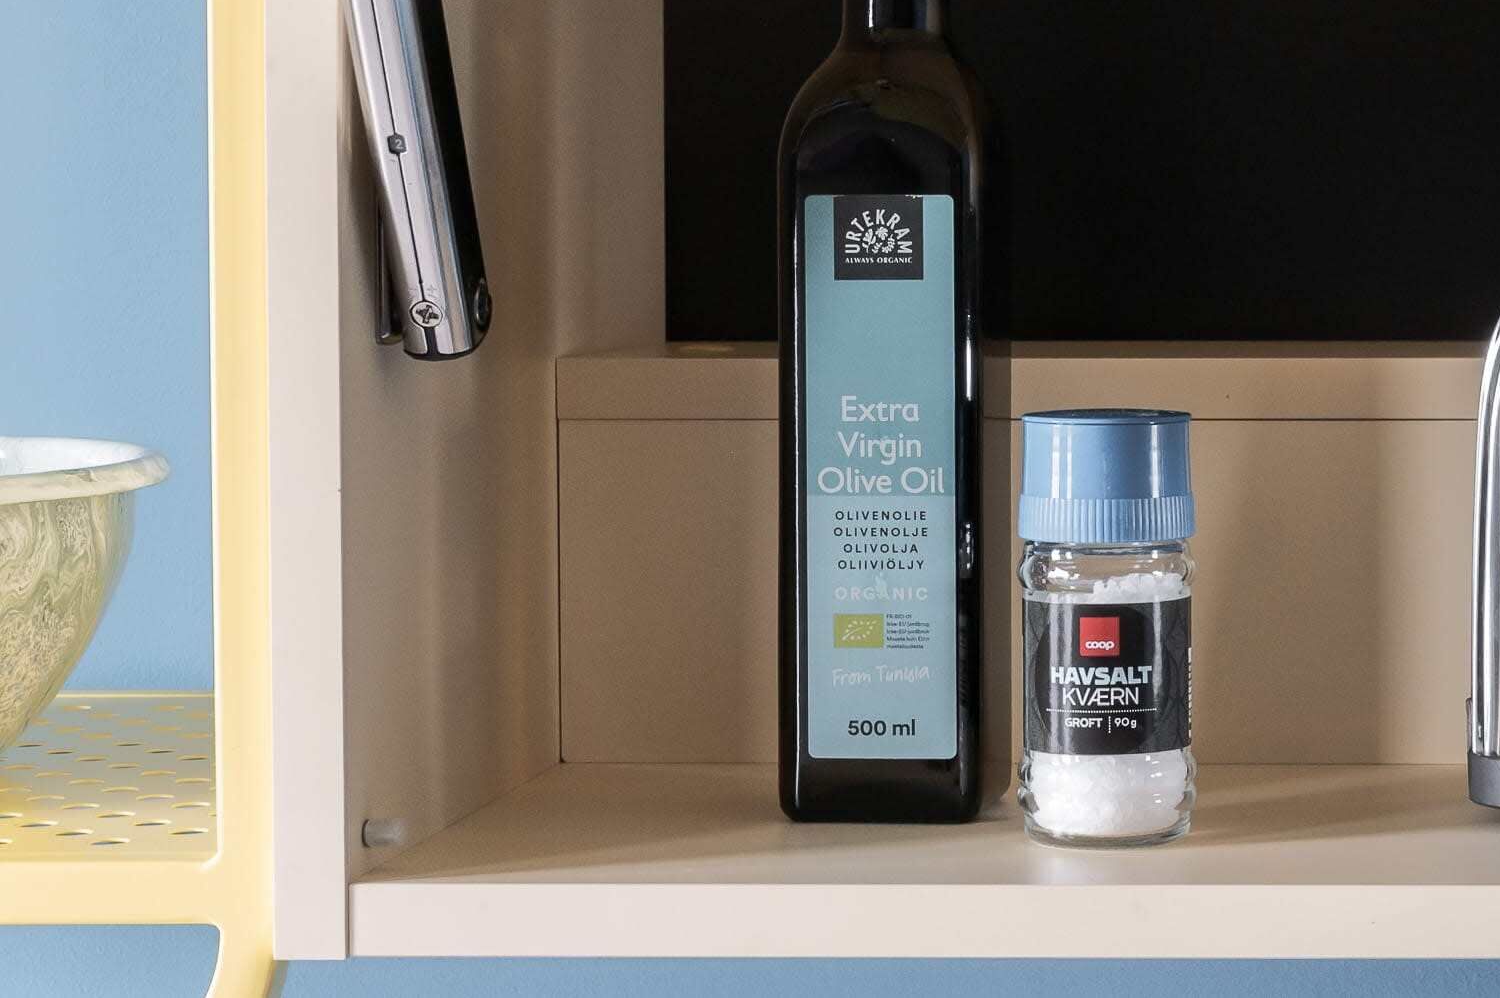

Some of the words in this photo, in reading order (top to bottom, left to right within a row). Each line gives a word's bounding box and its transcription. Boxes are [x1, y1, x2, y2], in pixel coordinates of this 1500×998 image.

[395, 139, 404, 149] 2
[844, 208, 913, 254] URTEKRAM
[845, 256, 875, 264] ALWAYS
[877, 256, 913, 264] ORGANIC
[841, 395, 920, 422] Extra
[837, 431, 922, 466] Virgin
[817, 466, 893, 494] Olive
[901, 466, 945, 494] Oil
[835, 510, 927, 521] OLIVENOLIE
[833, 527, 929, 537] OLIVENOLJE
[843, 543, 919, 553] OLIVOLJA
[837, 558, 925, 570] OLIIVIÖLJY
[834, 586, 929, 601] ORGANIC
[1085, 640, 1115, 651] coop
[832, 668, 871, 687] From
[875, 664, 930, 683] Tunisia
[1050, 666, 1152, 686] HAVSALT
[1062, 687, 1139, 706] KVÆRN
[848, 720, 887, 736] 500
[892, 718, 916, 736] ml
[1065, 717, 1103, 728] GROFT
[1114, 717, 1129, 727] 90
[1131, 719, 1137, 729] g
